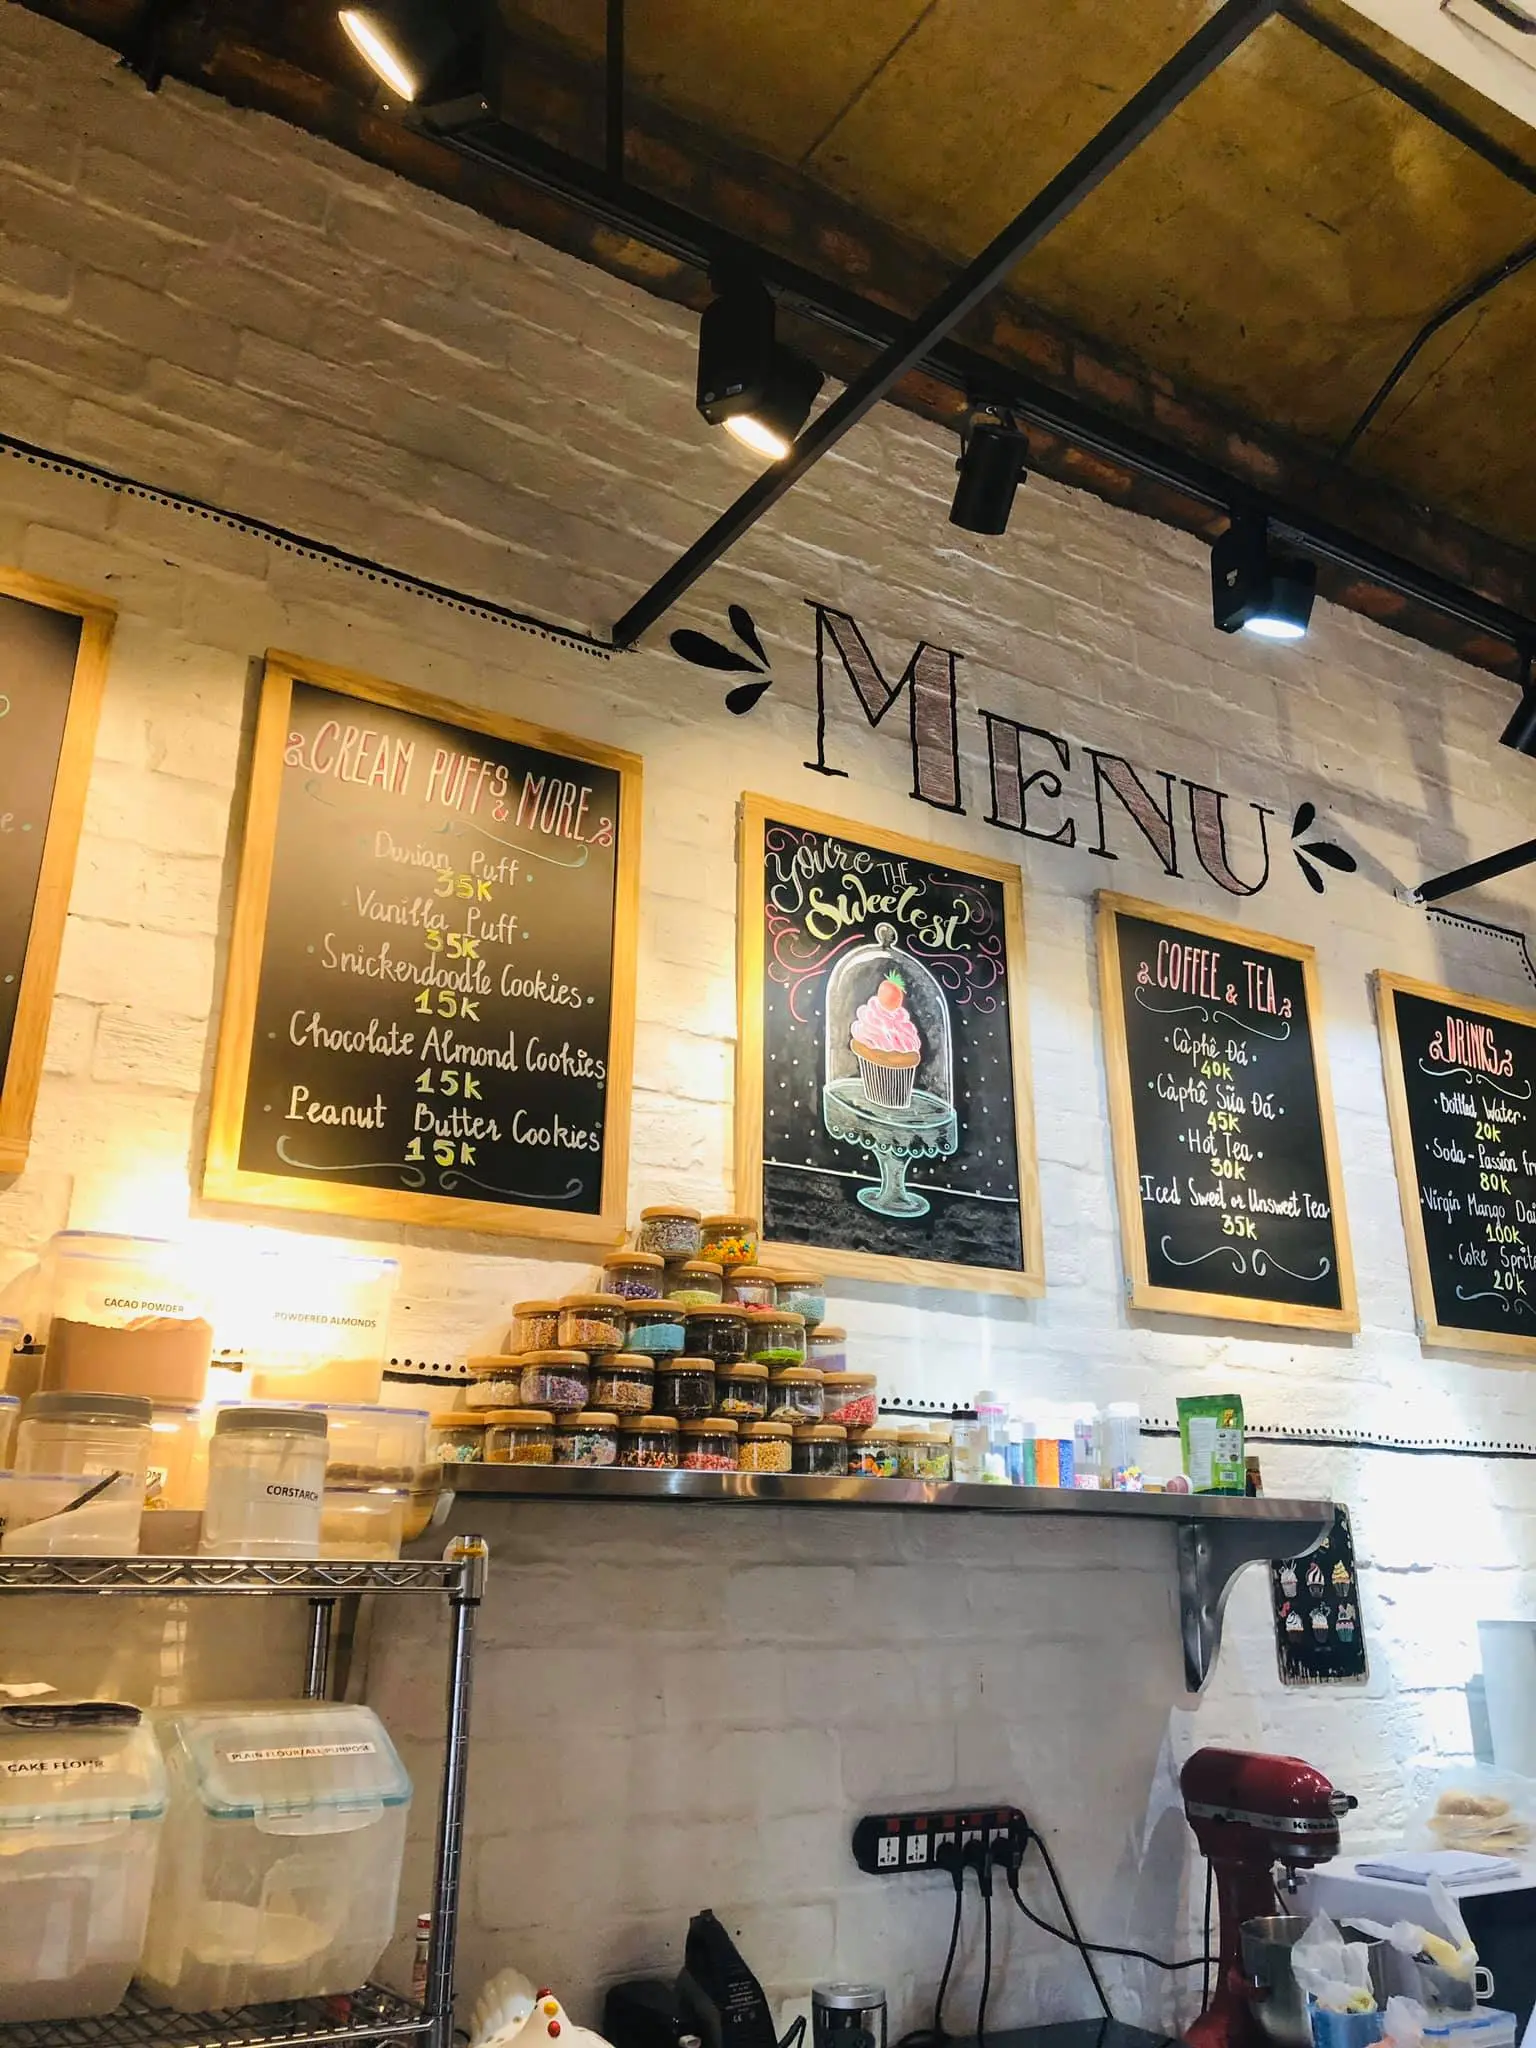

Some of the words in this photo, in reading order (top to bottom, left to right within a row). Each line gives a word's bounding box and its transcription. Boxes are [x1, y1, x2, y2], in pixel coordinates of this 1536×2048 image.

[804, 598, 1275, 897] MENU
[310, 720, 415, 796] CREAM
[426, 748, 510, 815] PUFFS
[515, 772, 593, 842] MORE
[374, 830, 453, 871] Durian
[470, 850, 520, 886] Puff
[764, 837, 874, 914] You're
[877, 861, 913, 887] THE
[355, 885, 450, 931] Vanilla
[461, 906, 518, 945] Puff
[805, 873, 971, 951] Sweetest
[321, 932, 492, 995] Snickerdoodle
[500, 964, 582, 1009] Cookies
[1157, 939, 1222, 1001] COFFEE
[1225, 983, 1240, 1007] &
[1242, 960, 1278, 1015] TEA
[289, 1010, 415, 1057] Chocolate
[420, 1026, 518, 1072] Almond
[525, 1037, 606, 1080] Cookies
[284, 1085, 388, 1130] Peanut
[414, 1102, 502, 1141] Butter
[512, 1109, 601, 1152] Cookies
[1482, 1096, 1521, 1126] Water
[1188, 1127, 1218, 1157] Hot
[1223, 1132, 1254, 1162] Tea
[1432, 1137, 1467, 1165] Soda
[1478, 1143, 1519, 1174] Passion
[1140, 1175, 1182, 1206] Iced
[1188, 1177, 1227, 1211] Sweet
[1230, 1194, 1247, 1211] or
[1248, 1187, 1303, 1218] Unsweet
[1302, 1193, 1330, 1220] Tea
[1422, 1185, 1461, 1225] Virgin
[1467, 1192, 1506, 1227] Mango
[1458, 1241, 1488, 1268] Coke
[104, 1297, 140, 1310] CACAO
[141, 1301, 185, 1313] POWDER
[274, 1311, 328, 1325] POWDERED
[330, 1316, 378, 1329] ALMONDS
[7, 1763, 49, 1773] CAKE
